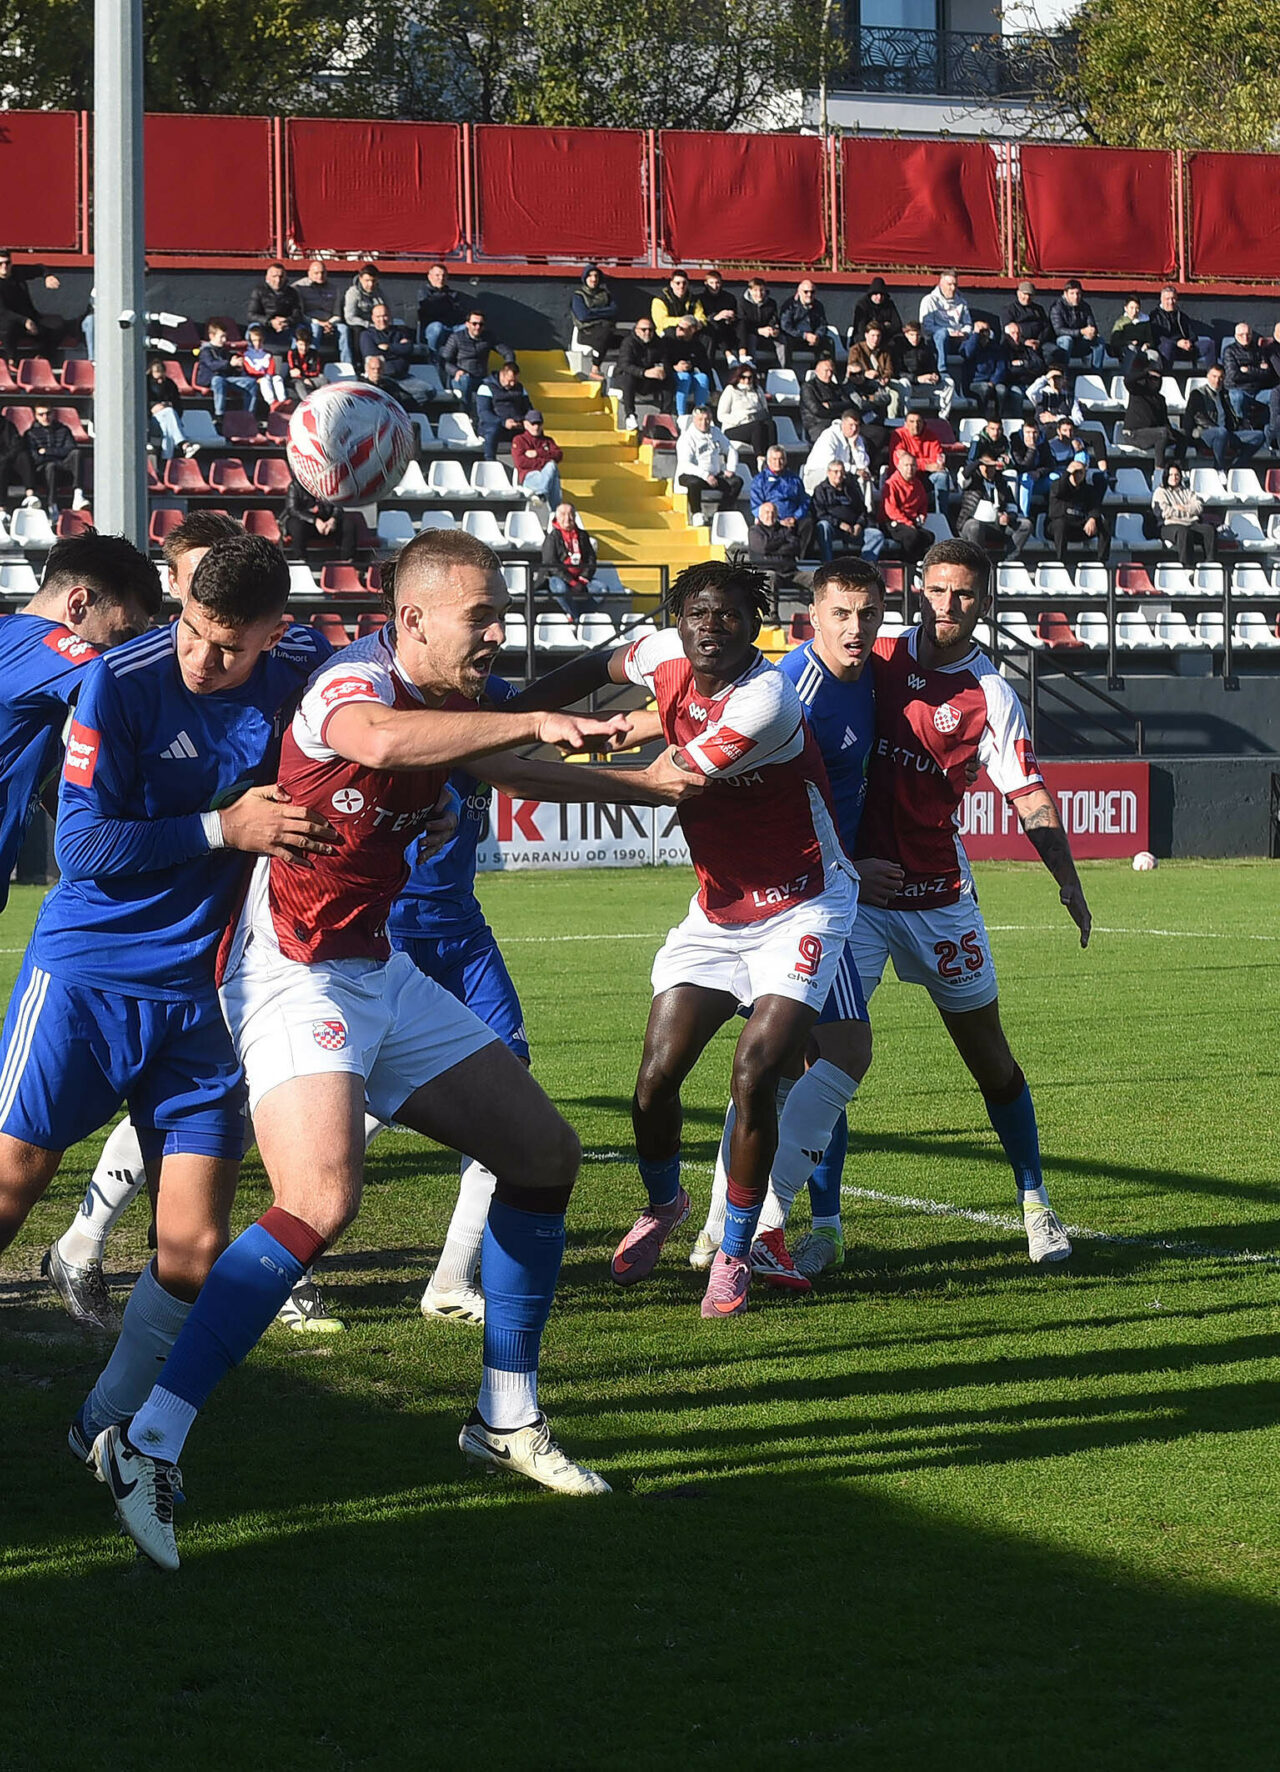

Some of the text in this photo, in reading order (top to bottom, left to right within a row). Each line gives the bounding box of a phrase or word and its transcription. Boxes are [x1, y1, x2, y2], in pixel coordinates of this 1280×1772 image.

[1057, 790, 1137, 835] TOKEN
[492, 850, 580, 864] STVARANJU
[586, 848, 606, 862] OD
[795, 934, 823, 977] 9
[933, 929, 984, 978] 25
